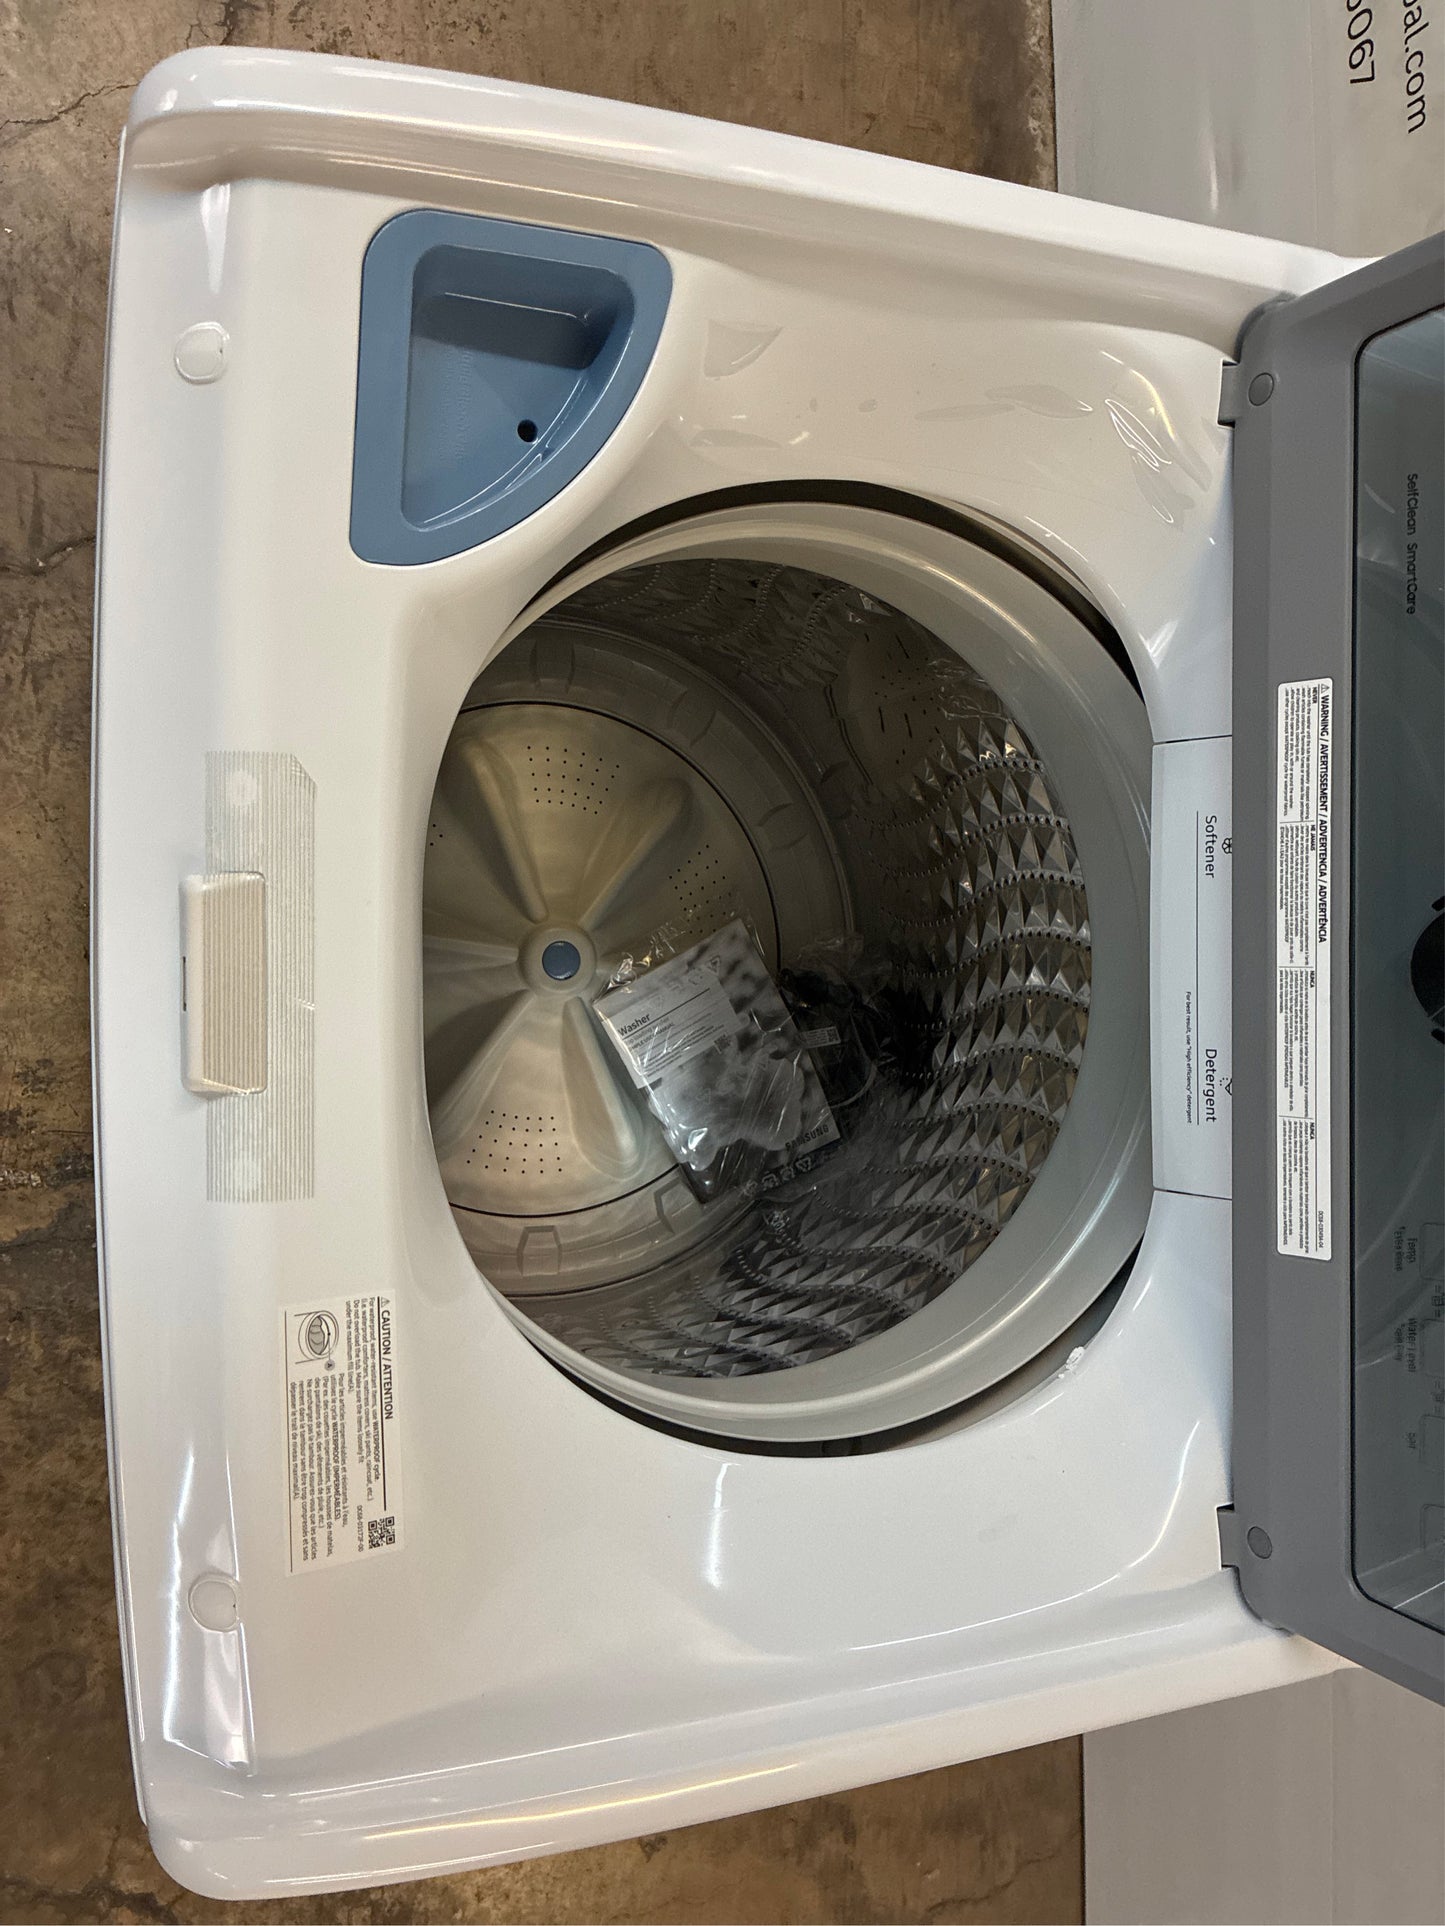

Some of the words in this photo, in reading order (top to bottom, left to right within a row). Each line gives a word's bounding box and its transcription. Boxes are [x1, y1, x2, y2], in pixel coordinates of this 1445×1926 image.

[1407, 474, 1418, 535] SelfClean
[1406, 542, 1418, 614] SmartCare
[1320, 695, 1329, 736] WARNING
[1320, 744, 1329, 811] AVERTISSEMENT
[1204, 815, 1218, 878] Softener
[1319, 819, 1328, 876] ADVERTENCIA
[1319, 884, 1328, 943] ADVERTÊNCIA
[618, 1013, 651, 1037] Washer
[1203, 1048, 1218, 1122] Detergent
[784, 1124, 830, 1152] SAMSUNG
[381, 1310, 391, 1354] CAUTION
[383, 1364, 393, 1420] ATTENTION
